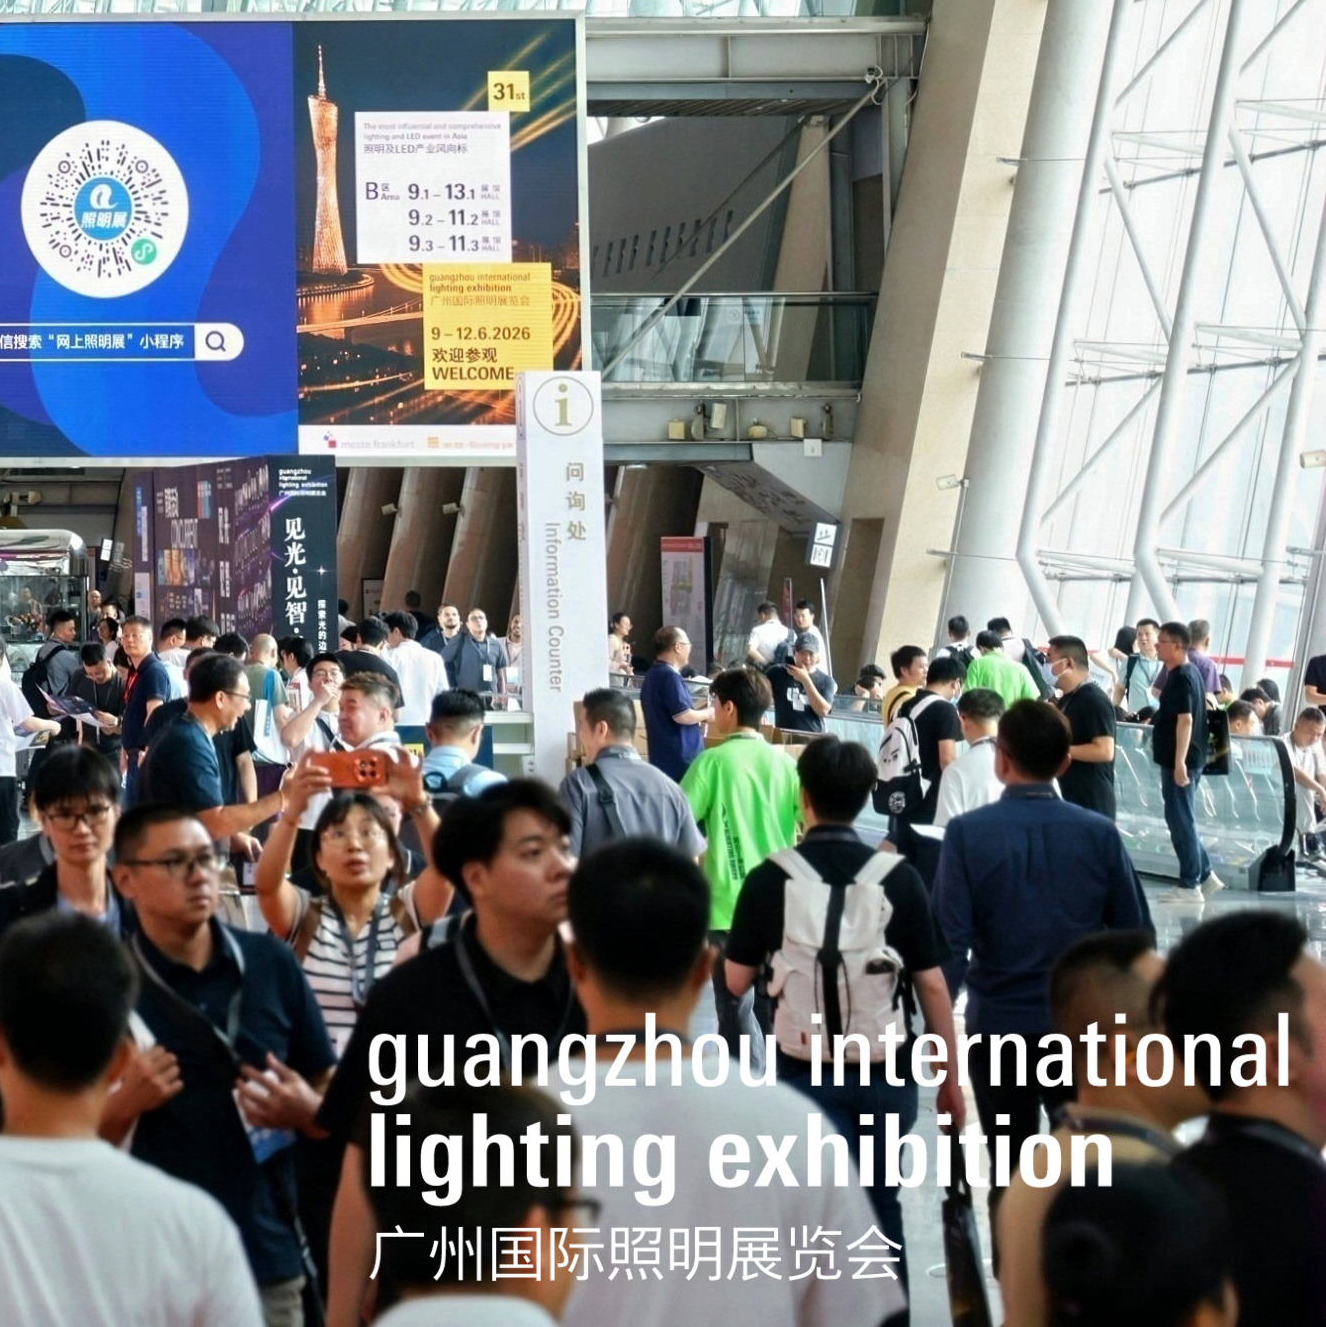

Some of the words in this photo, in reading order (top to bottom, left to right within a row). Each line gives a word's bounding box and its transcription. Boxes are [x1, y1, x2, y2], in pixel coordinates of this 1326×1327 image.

[363, 133, 390, 141] lighting
[363, 144, 468, 154] 照明及LED产业风向标
[381, 193, 400, 201] Area
[80, 211, 127, 228] 照明展
[429, 274, 475, 283] guangzhou
[477, 272, 531, 281] international
[430, 283, 464, 293] lighting
[467, 283, 512, 292] exhibition
[430, 295, 530, 306] 广州国际照明展览会
[432, 348, 497, 363] 欢迎参观
[432, 367, 514, 380] WELCOME
[565, 461, 587, 542] 问询处
[545, 522, 562, 619] Information
[317, 599, 327, 653] 探索光的边
[547, 627, 565, 692] Counter
